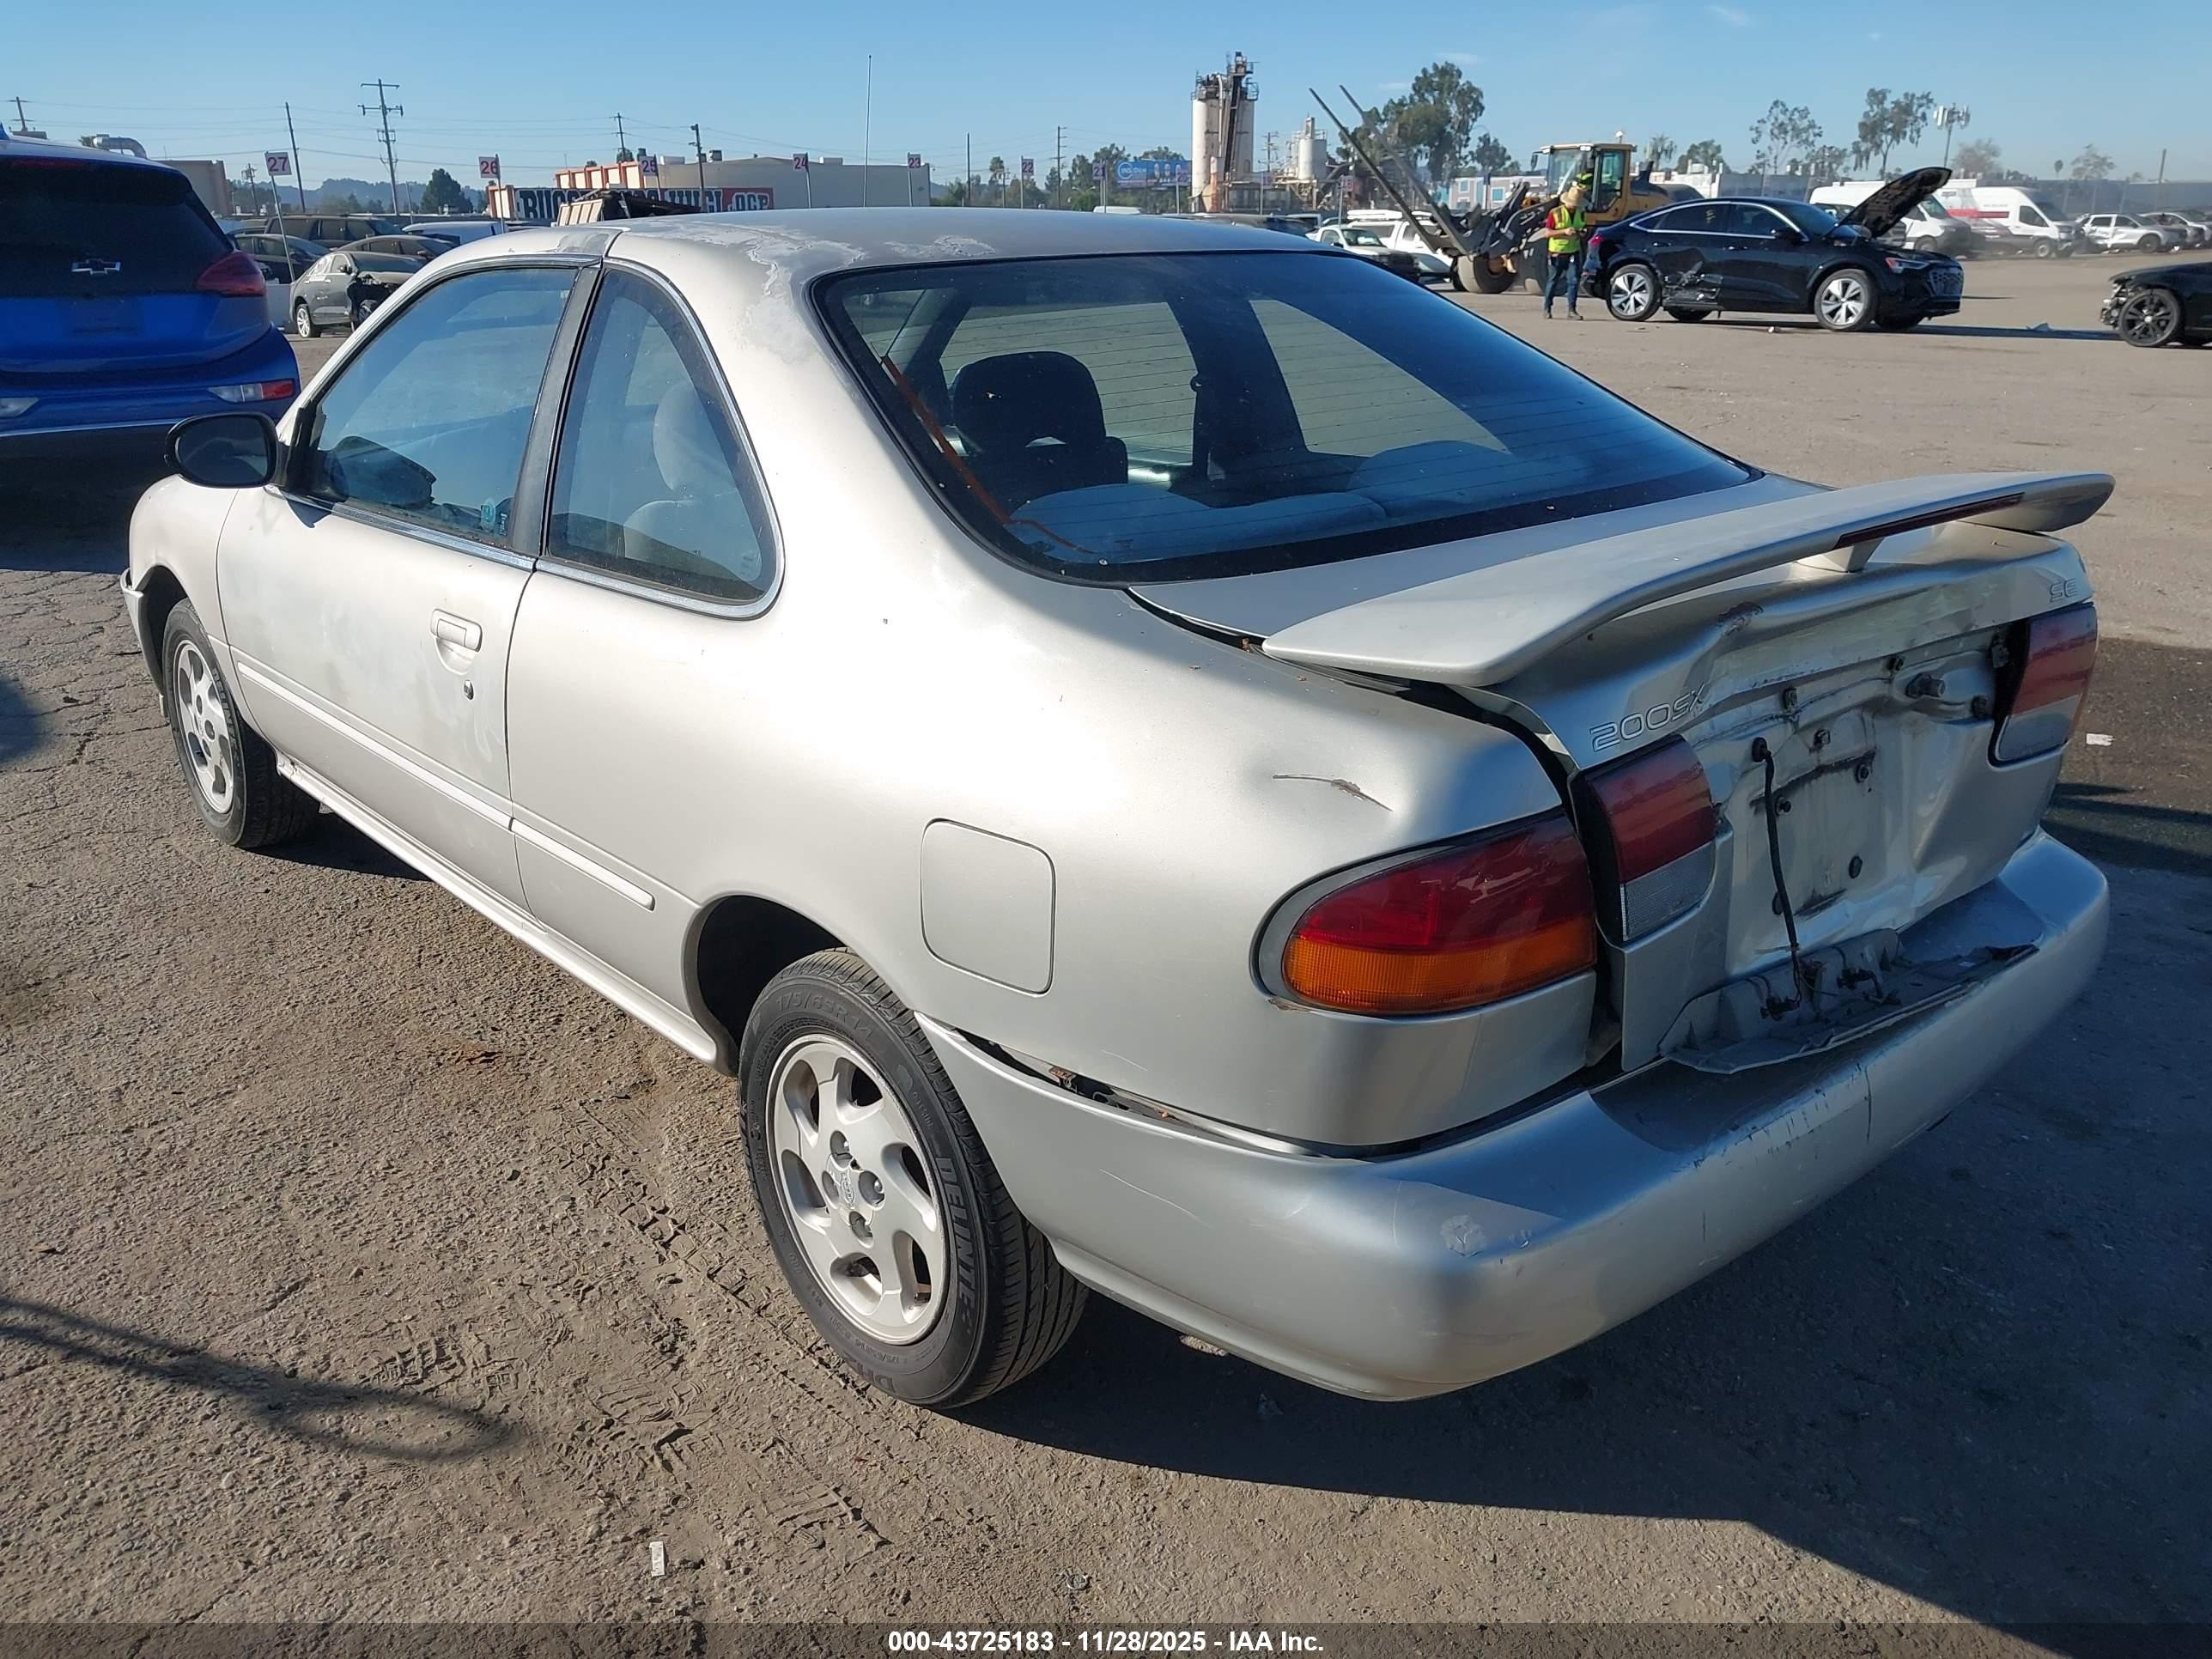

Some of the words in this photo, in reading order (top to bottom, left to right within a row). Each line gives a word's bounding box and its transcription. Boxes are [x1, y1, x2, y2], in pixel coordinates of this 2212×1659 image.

[267, 156, 289, 172] 27
[480, 161, 498, 174] 26
[641, 160, 656, 173] 25
[793, 157, 808, 169] 24
[908, 157, 921, 168] 23
[1022, 161, 1034, 173] 22
[1094, 166, 1105, 177] 21
[2049, 577, 2078, 603] SE
[1589, 680, 1706, 753] 200SX
[935, 1157, 976, 1310] DELINTE
